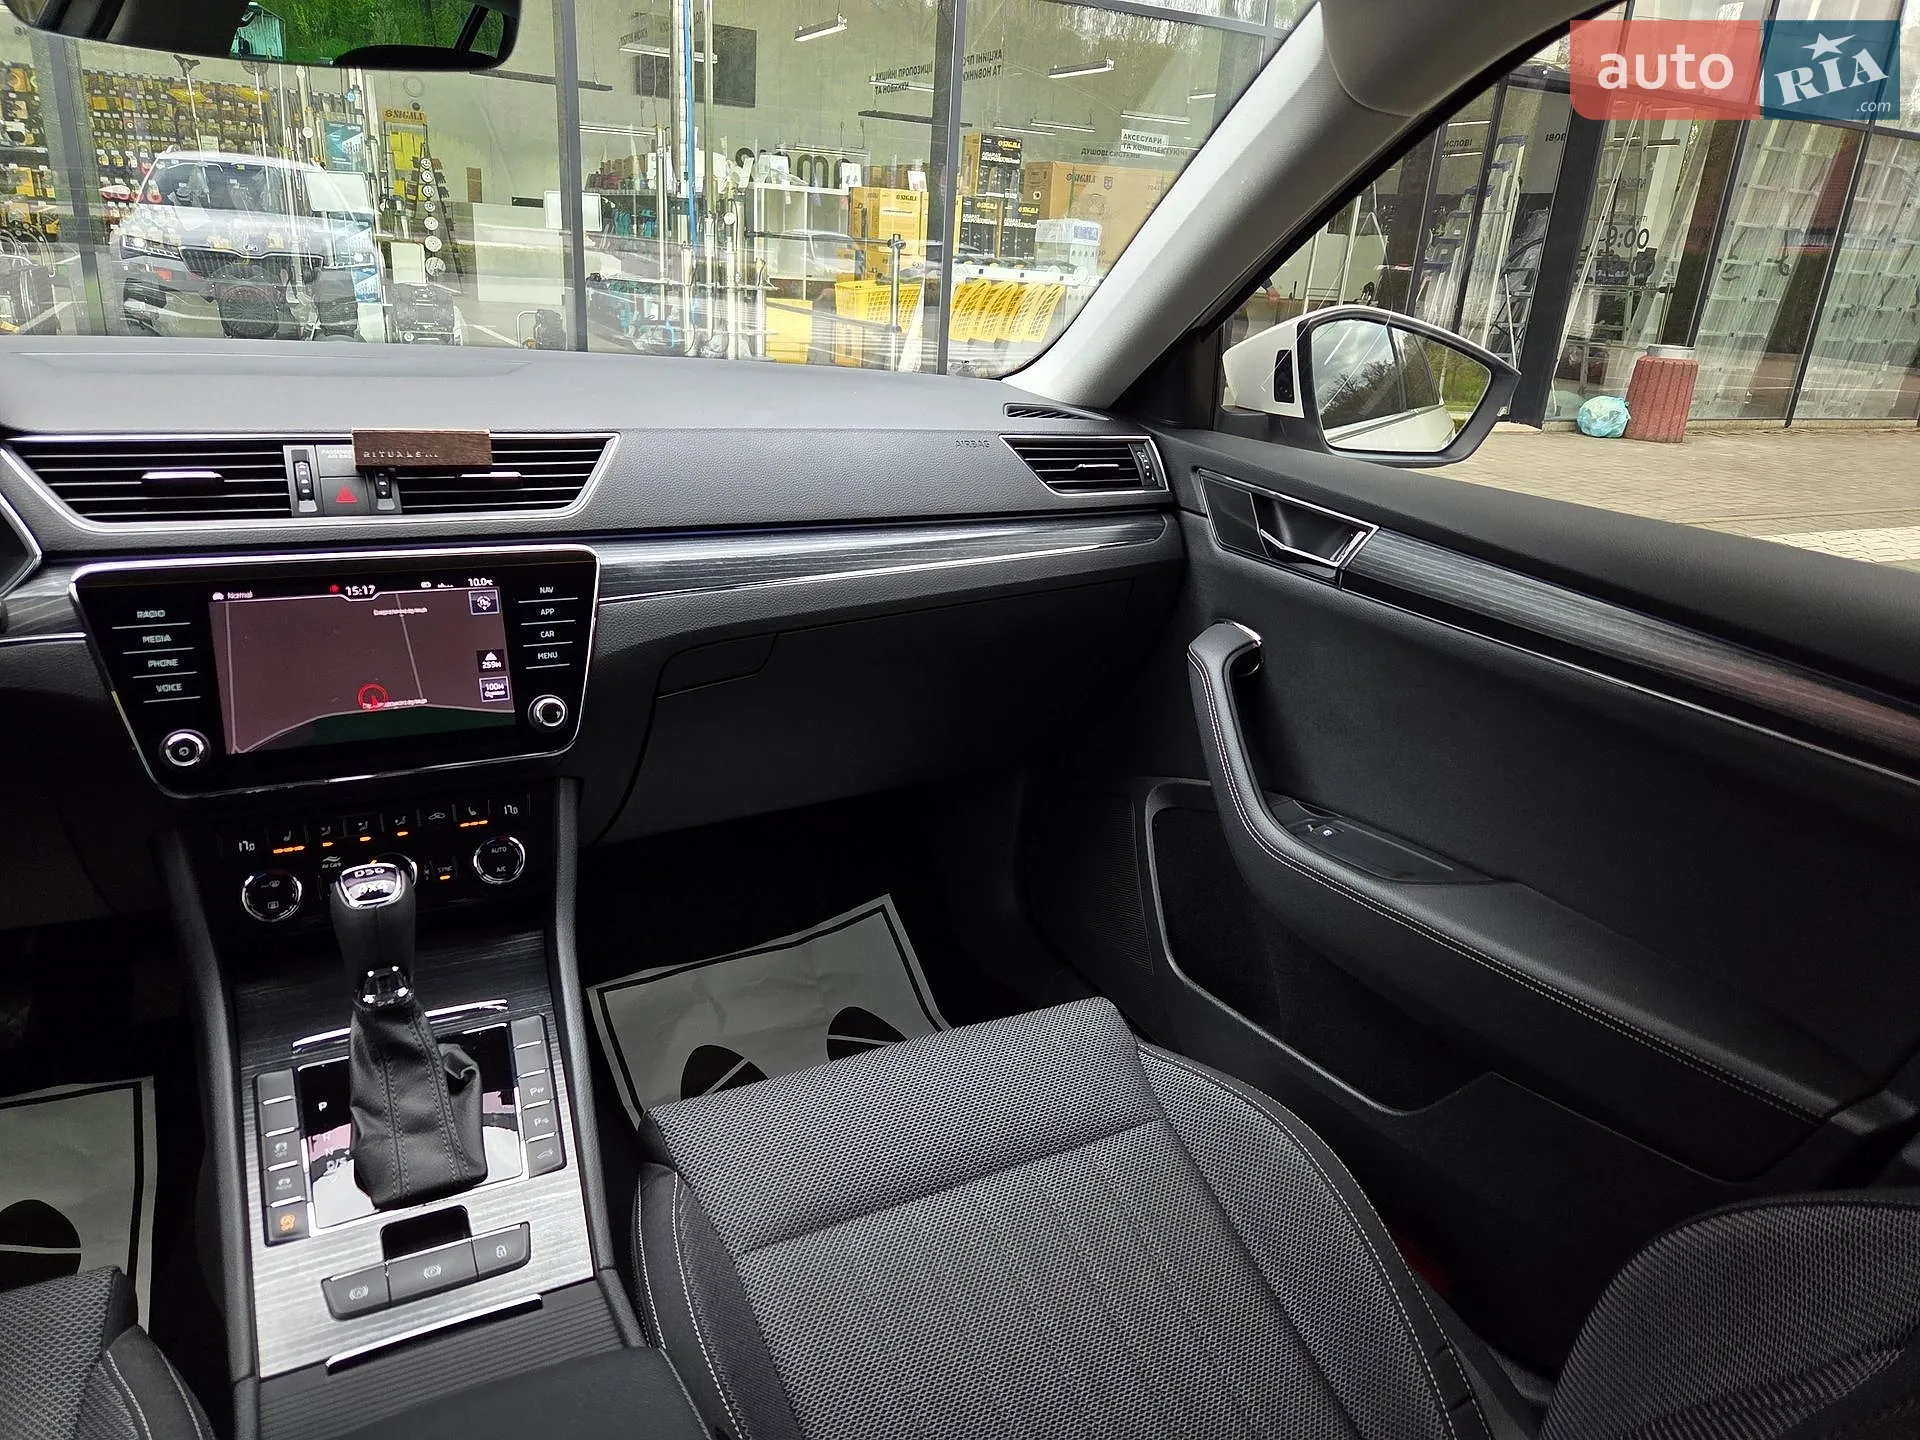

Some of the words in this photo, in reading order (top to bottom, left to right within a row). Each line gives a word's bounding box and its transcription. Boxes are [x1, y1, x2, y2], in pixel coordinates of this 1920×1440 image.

[392, 110, 425, 121] SIGMA
[1123, 133, 1162, 144] АКСЕСУАРИ
[955, 439, 991, 449] AIRBAG
[227, 590, 253, 600] Normal
[345, 584, 376, 596] 15:17
[539, 586, 554, 594] NAV
[136, 609, 166, 619] RADIO
[540, 608, 555, 616] APP
[142, 634, 172, 643] MEDIA
[540, 630, 555, 638] CAR
[537, 651, 558, 660] MENU
[147, 658, 179, 668] PHONE
[156, 683, 183, 693] VOICE
[491, 846, 507, 854] AUTO
[354, 868, 385, 878] DSG
[318, 1101, 328, 1111] P
